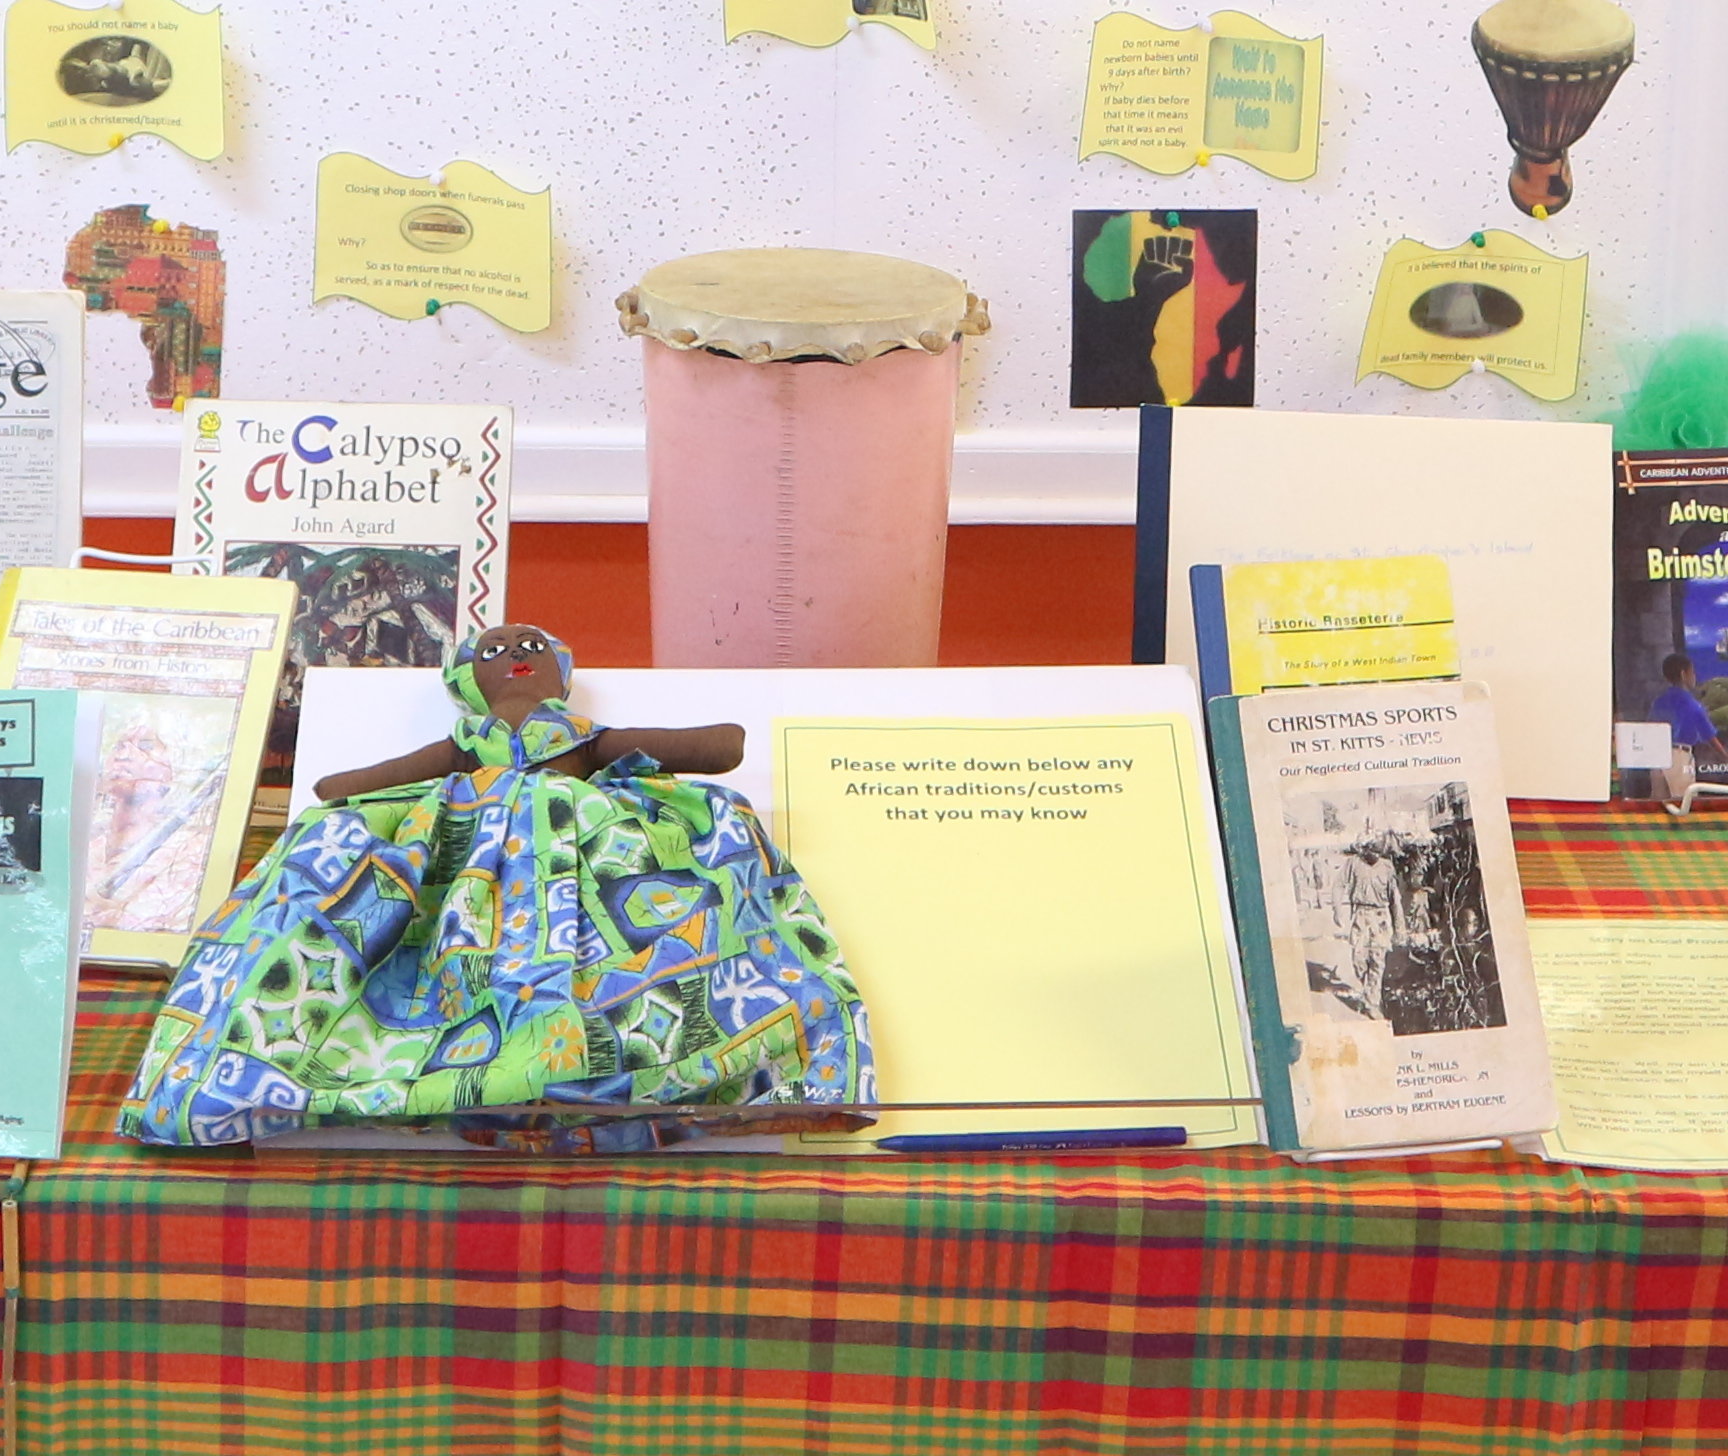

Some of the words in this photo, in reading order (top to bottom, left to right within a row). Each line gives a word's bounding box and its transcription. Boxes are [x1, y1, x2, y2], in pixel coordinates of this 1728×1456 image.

[1123, 40, 1134, 49] Do
[1137, 40, 1151, 48] not
[1104, 55, 1142, 63] newborn
[345, 184, 380, 196] Closing
[383, 186, 406, 197] shop
[409, 188, 436, 198] doors
[439, 190, 465, 200] when
[468, 192, 504, 206] funerals
[506, 201, 525, 210] pass
[236, 420, 284, 443] The
[292, 415, 462, 465] Calypso
[1640, 468, 1688, 478] CARIBBEAN
[292, 517, 333, 533] John
[340, 518, 394, 537] Agard
[31, 610, 74, 630] Tales
[84, 616, 104, 633] of
[112, 618, 146, 636] the
[154, 620, 260, 642] Caribbean
[1268, 712, 1377, 732] CHRISTMAS
[1384, 706, 1457, 724] SPORTS
[1290, 739, 1306, 753] IN
[1312, 738, 1335, 752] ST.
[1340, 736, 1384, 750] KITTS
[831, 758, 895, 771] Please
[903, 759, 956, 771] write
[964, 758, 1020, 771] down
[1028, 758, 1090, 771] below
[1098, 760, 1133, 771] any
[1280, 768, 1300, 776] Our
[1305, 762, 1360, 775] Neglected
[1365, 759, 1408, 770] Cultural
[1412, 757, 1461, 767] Tradition
[846, 783, 918, 795] African
[926, 782, 1123, 797] traditions/customs
[886, 807, 928, 820] that
[935, 810, 972, 822] you
[981, 810, 1023, 822] may
[1031, 807, 1087, 819] know
